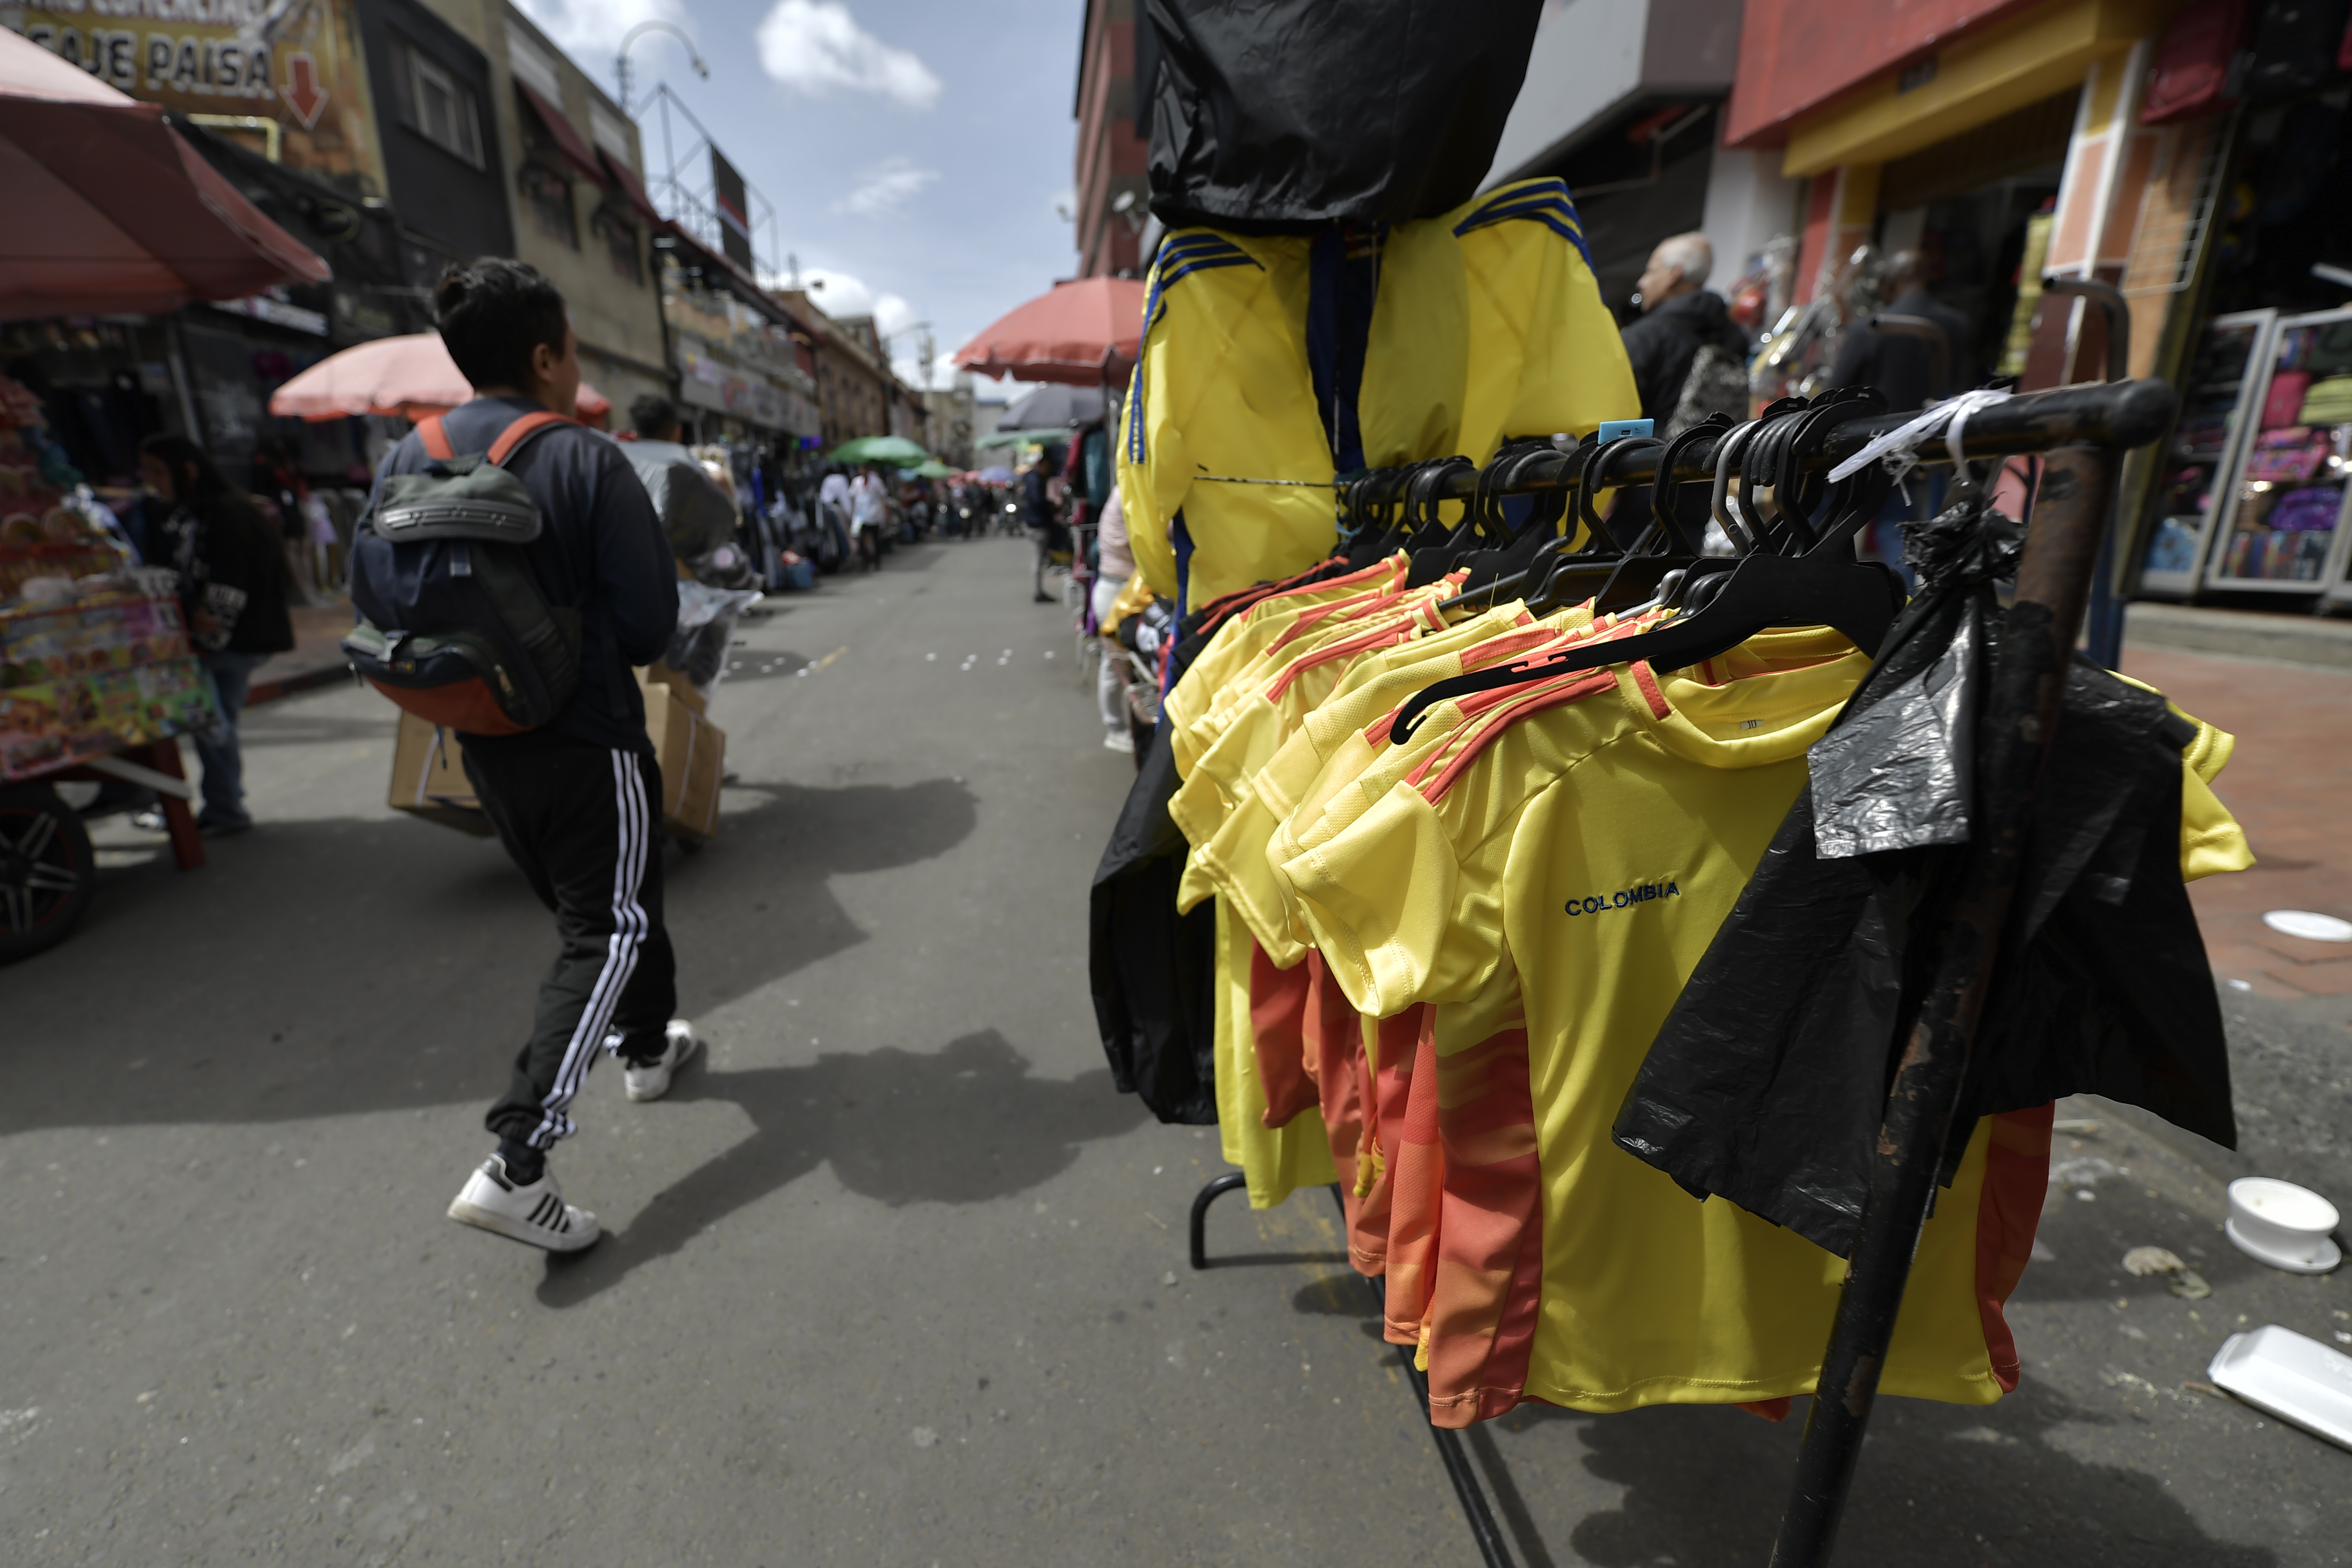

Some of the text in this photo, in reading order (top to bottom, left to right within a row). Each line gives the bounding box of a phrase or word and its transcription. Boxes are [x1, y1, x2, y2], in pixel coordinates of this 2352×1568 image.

[149, 35, 273, 92] PAISA
[1747, 720, 1757, 729] 10
[1565, 881, 1680, 916] COLOMBIA
